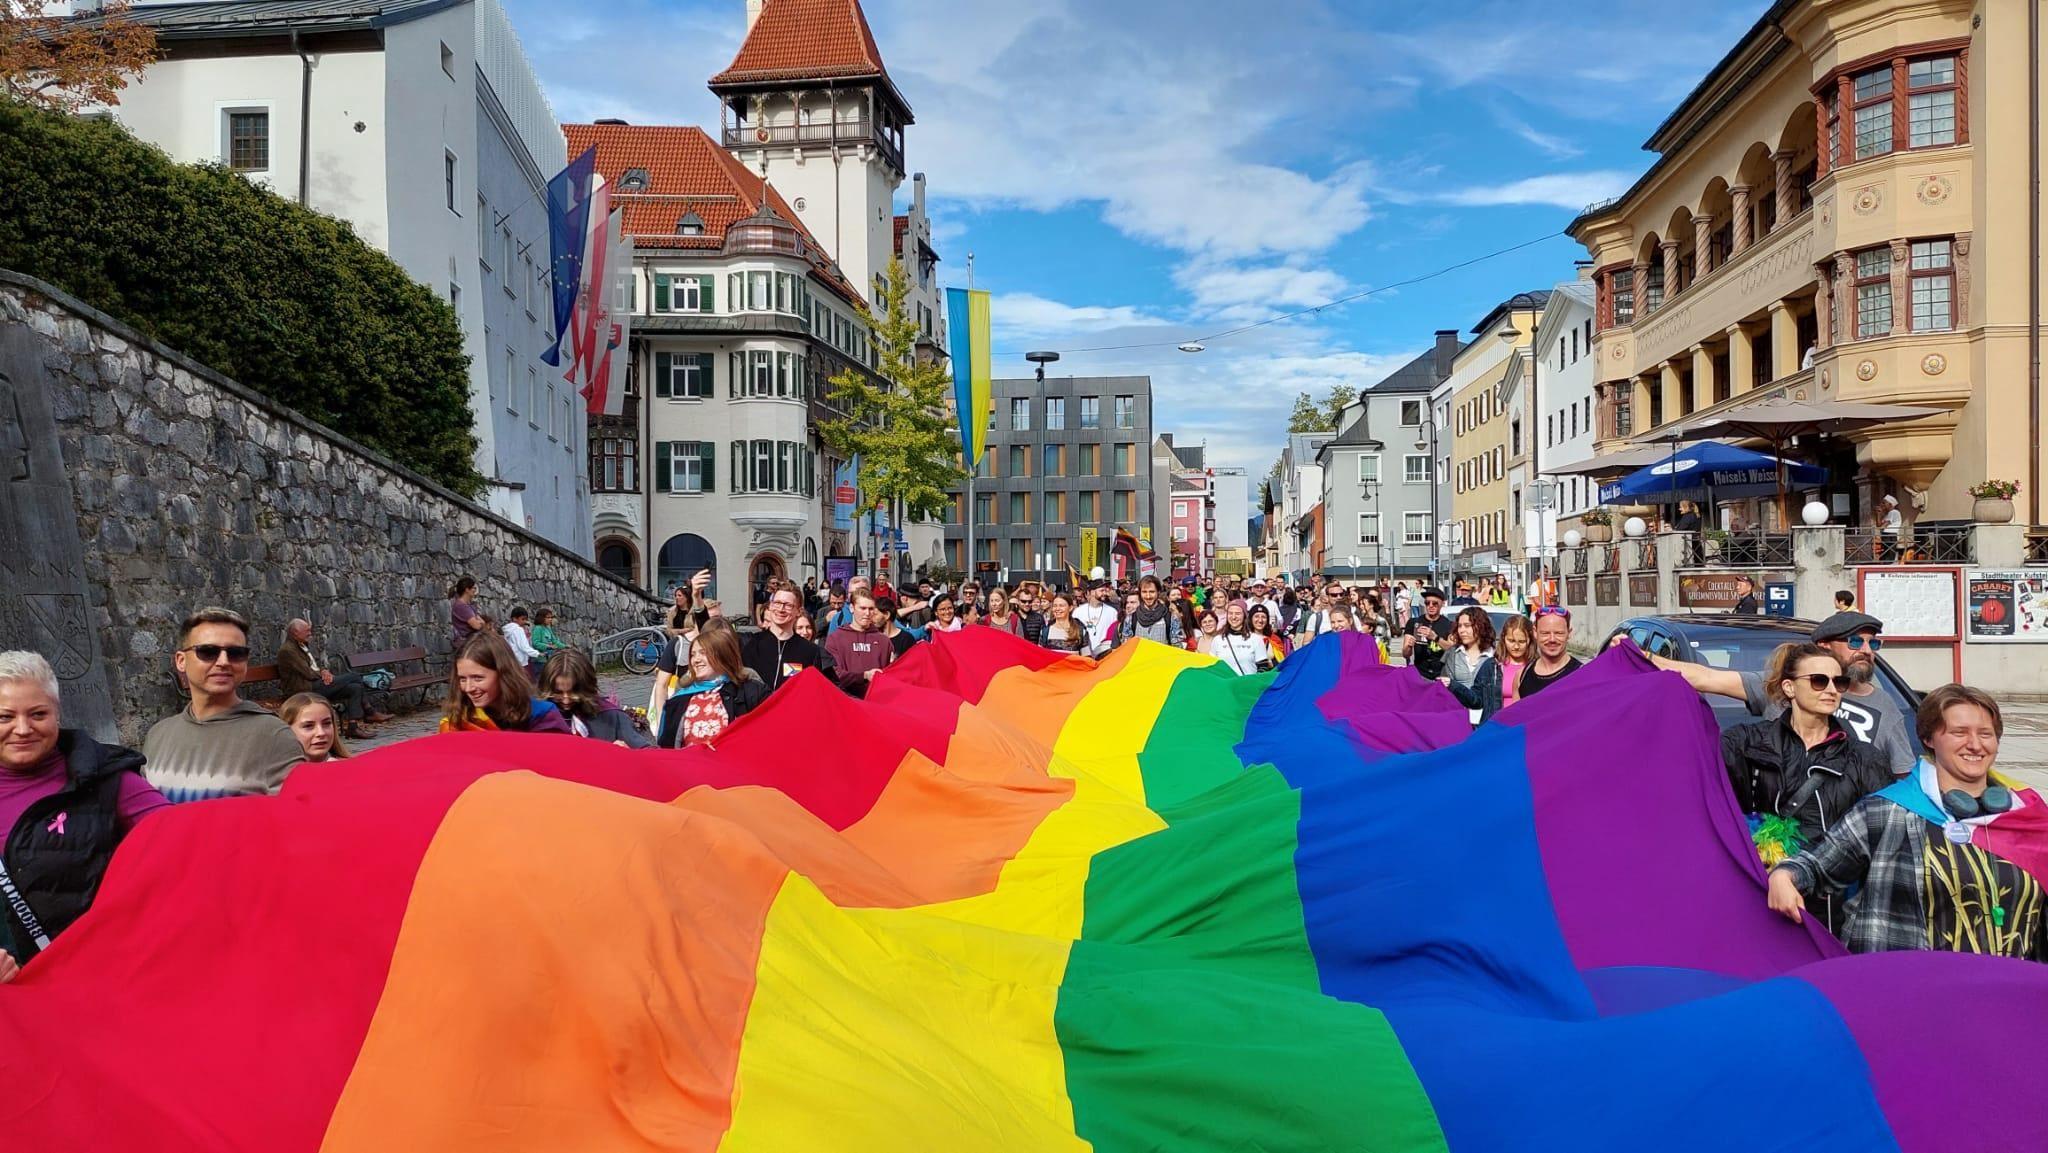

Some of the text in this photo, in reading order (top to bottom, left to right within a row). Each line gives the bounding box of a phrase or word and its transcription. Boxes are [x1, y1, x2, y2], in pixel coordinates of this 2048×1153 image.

[1713, 471, 1747, 485] Maisel's
[24, 560, 77, 579] KINK
[1981, 572, 2022, 580] Stadttheater
[1971, 583, 2014, 593] CABARET
